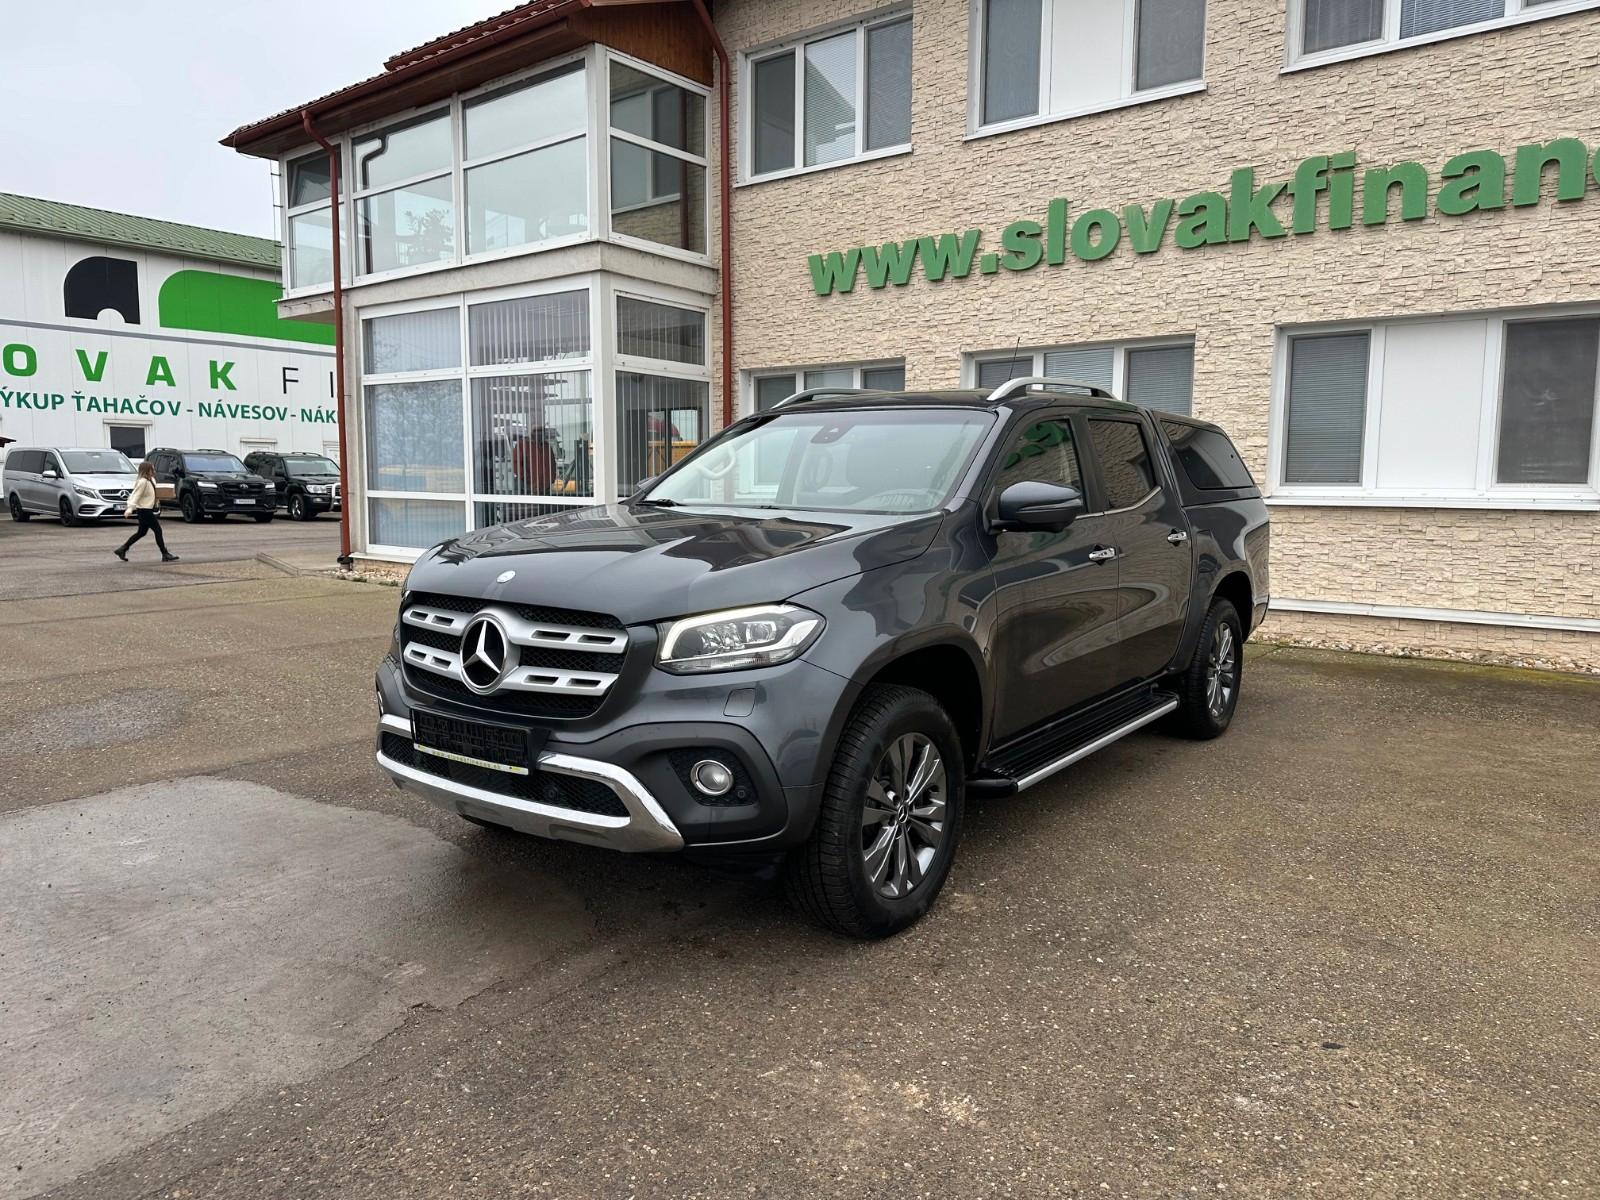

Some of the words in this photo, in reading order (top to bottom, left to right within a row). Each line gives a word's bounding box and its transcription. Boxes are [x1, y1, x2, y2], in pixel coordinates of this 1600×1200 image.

[807, 137, 1600, 295] www.slovakfinan
[71, 390, 181, 416] ŤAHAČOV
[198, 399, 288, 421] NÁVESOV
